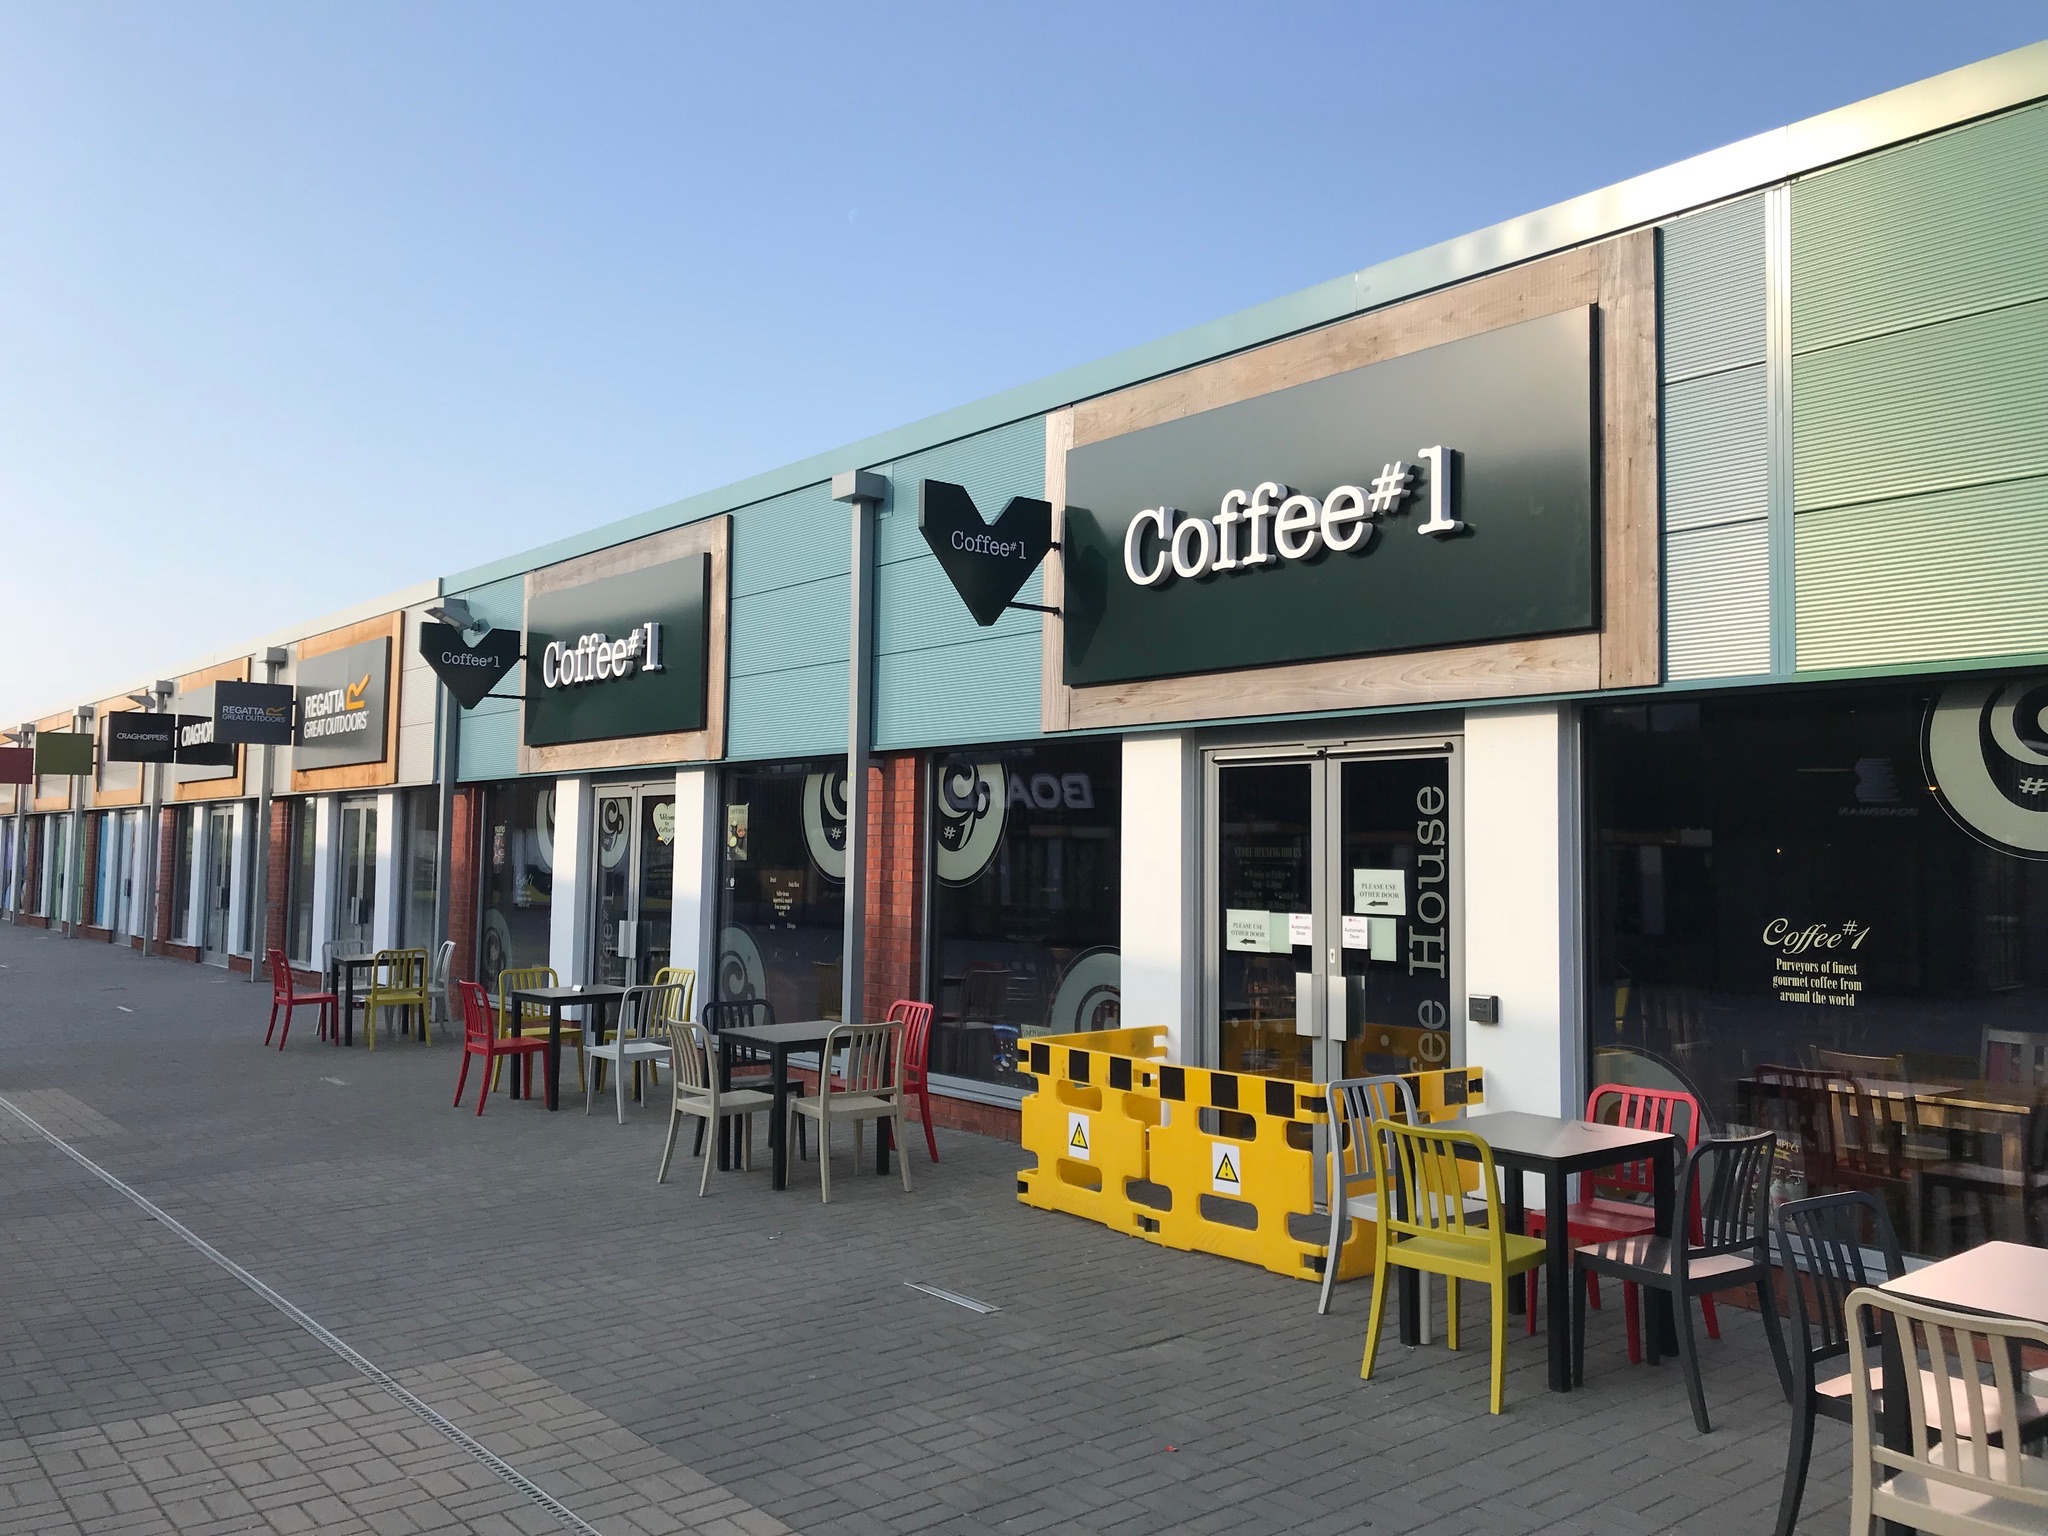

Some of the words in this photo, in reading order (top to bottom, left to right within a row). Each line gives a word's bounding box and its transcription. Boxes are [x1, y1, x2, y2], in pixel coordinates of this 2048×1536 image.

[1124, 445, 1464, 586] Coffee#1
[951, 530, 1027, 560] Coffee#1
[441, 651, 500, 668] Coffee#1
[543, 622, 663, 688] Coffee#1
[222, 705, 264, 715] REGATTA
[304, 688, 346, 719] REGATTA
[245, 714, 286, 723] OUTDOORS
[303, 718, 327, 738] GREAT
[325, 710, 368, 736] OUTDOORS
[116, 732, 169, 742] CRAGHOPPERS
[1408, 786, 1446, 979] House
[1232, 922, 1252, 930] PLEASE
[1249, 930, 1265, 938] DOOR
[1762, 917, 1871, 955] Coffee#1
[1776, 957, 1819, 975] Purveyors
[1821, 961, 1831, 974] of
[1832, 961, 1858, 976] finest
[1772, 975, 1809, 989] gourmet
[1810, 976, 1838, 990] coffee
[1840, 977, 1862, 992] from
[1779, 991, 1811, 1004] around
[1812, 991, 1827, 1005] the
[1828, 993, 1855, 1007] world
